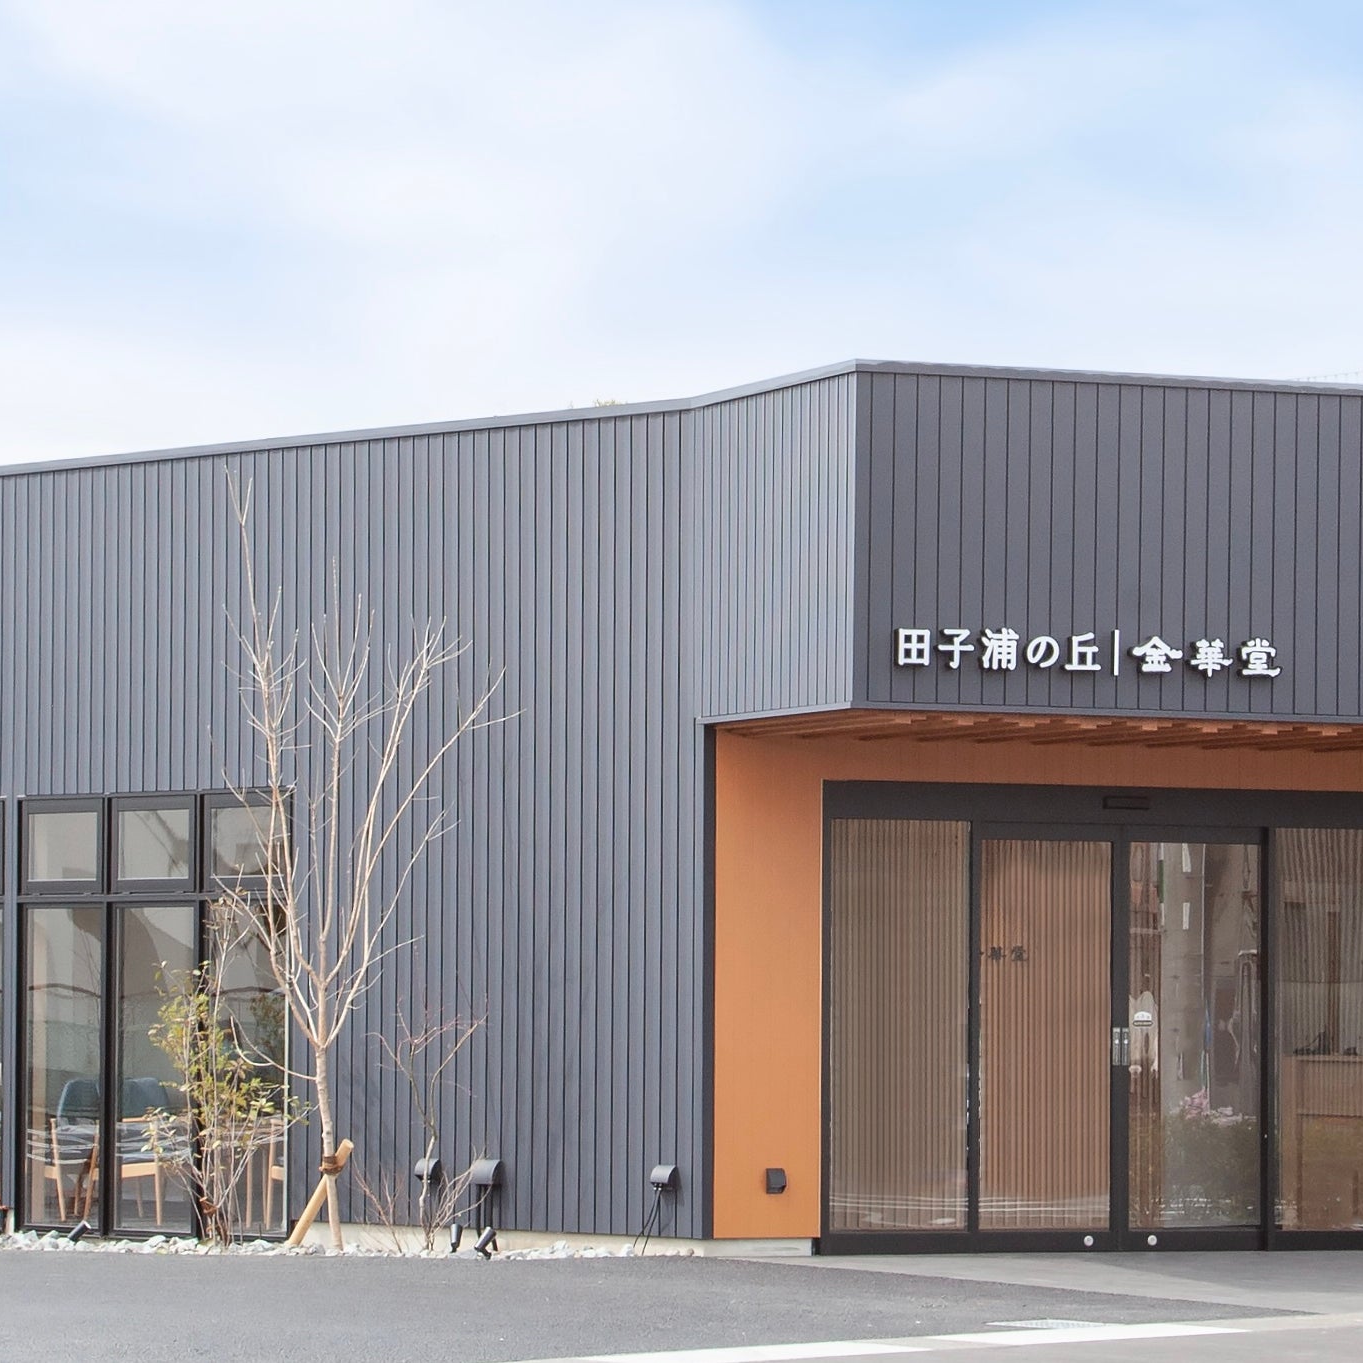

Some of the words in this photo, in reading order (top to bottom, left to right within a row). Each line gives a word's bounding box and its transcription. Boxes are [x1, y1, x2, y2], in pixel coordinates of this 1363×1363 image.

[896, 626, 1103, 672] 田子浦の丘
[1131, 635, 1282, 679] 金華堂
